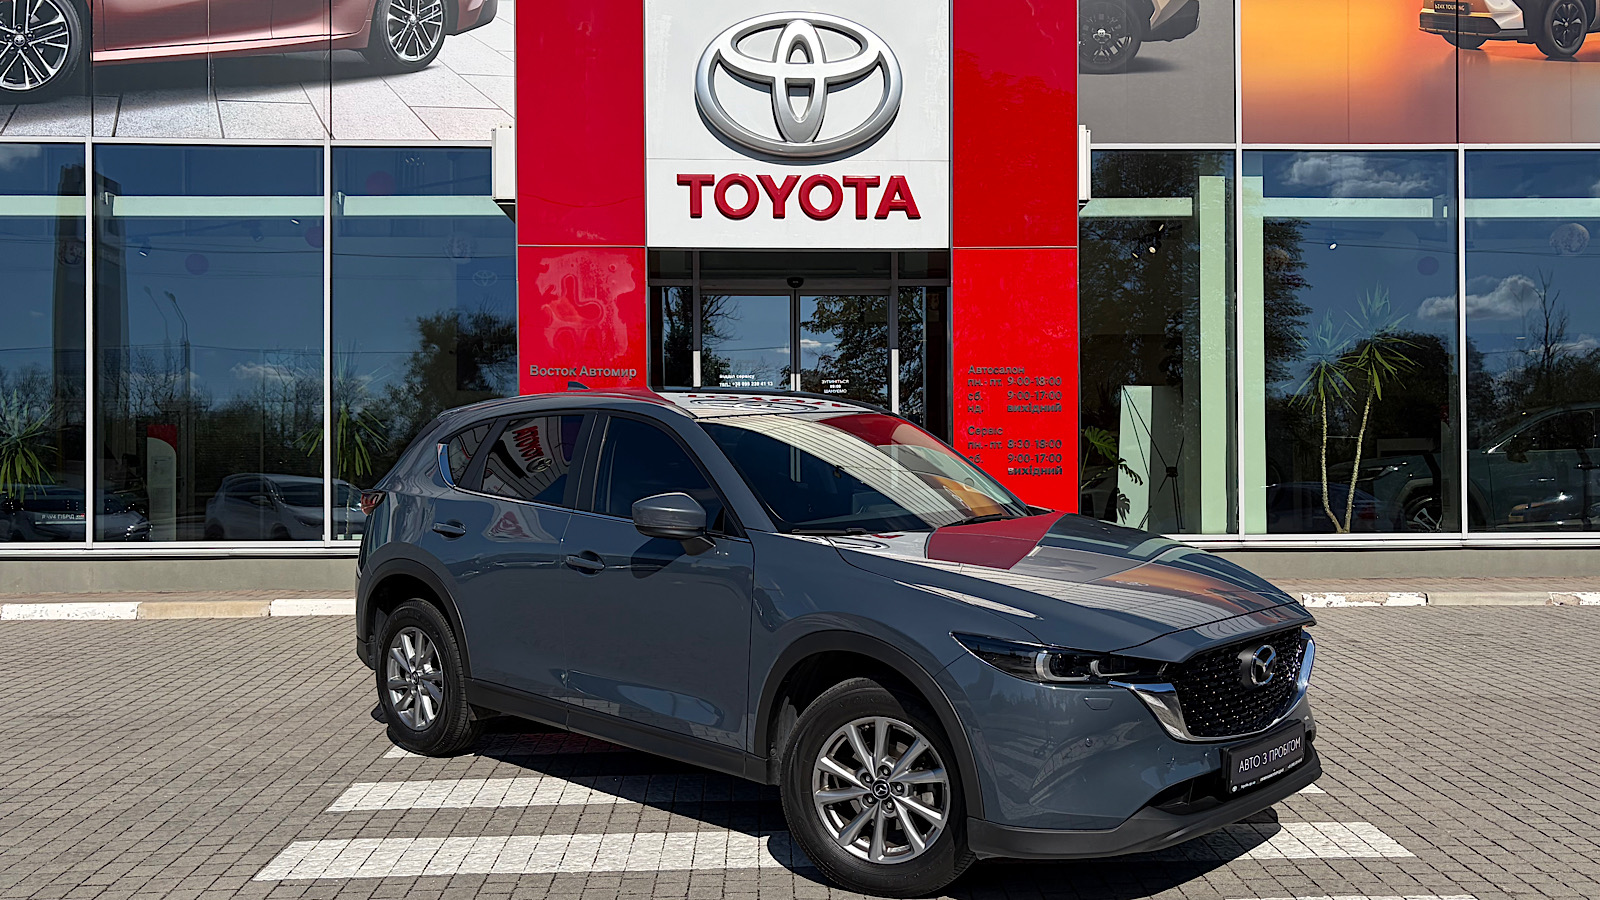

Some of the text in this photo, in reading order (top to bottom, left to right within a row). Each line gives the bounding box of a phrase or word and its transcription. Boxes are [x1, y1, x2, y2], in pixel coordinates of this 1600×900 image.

[676, 173, 921, 221] TOYOTA
[529, 365, 637, 380] Восток Автомир
[967, 364, 1025, 375] Автосалон
[1007, 376, 1062, 387] 9:00-18:00
[967, 390, 1062, 401] сб. 9:00-17:00
[967, 402, 1062, 414] нд. вихідний
[967, 425, 1004, 437] Сервіс
[1007, 439, 1062, 449] 8:30-18:00
[1007, 453, 1062, 463] 9:00-17:00
[1007, 465, 1063, 476] вихідний
[1238, 755, 1261, 773] АВТО
[1269, 736, 1301, 762] ПРОБІГОМ
